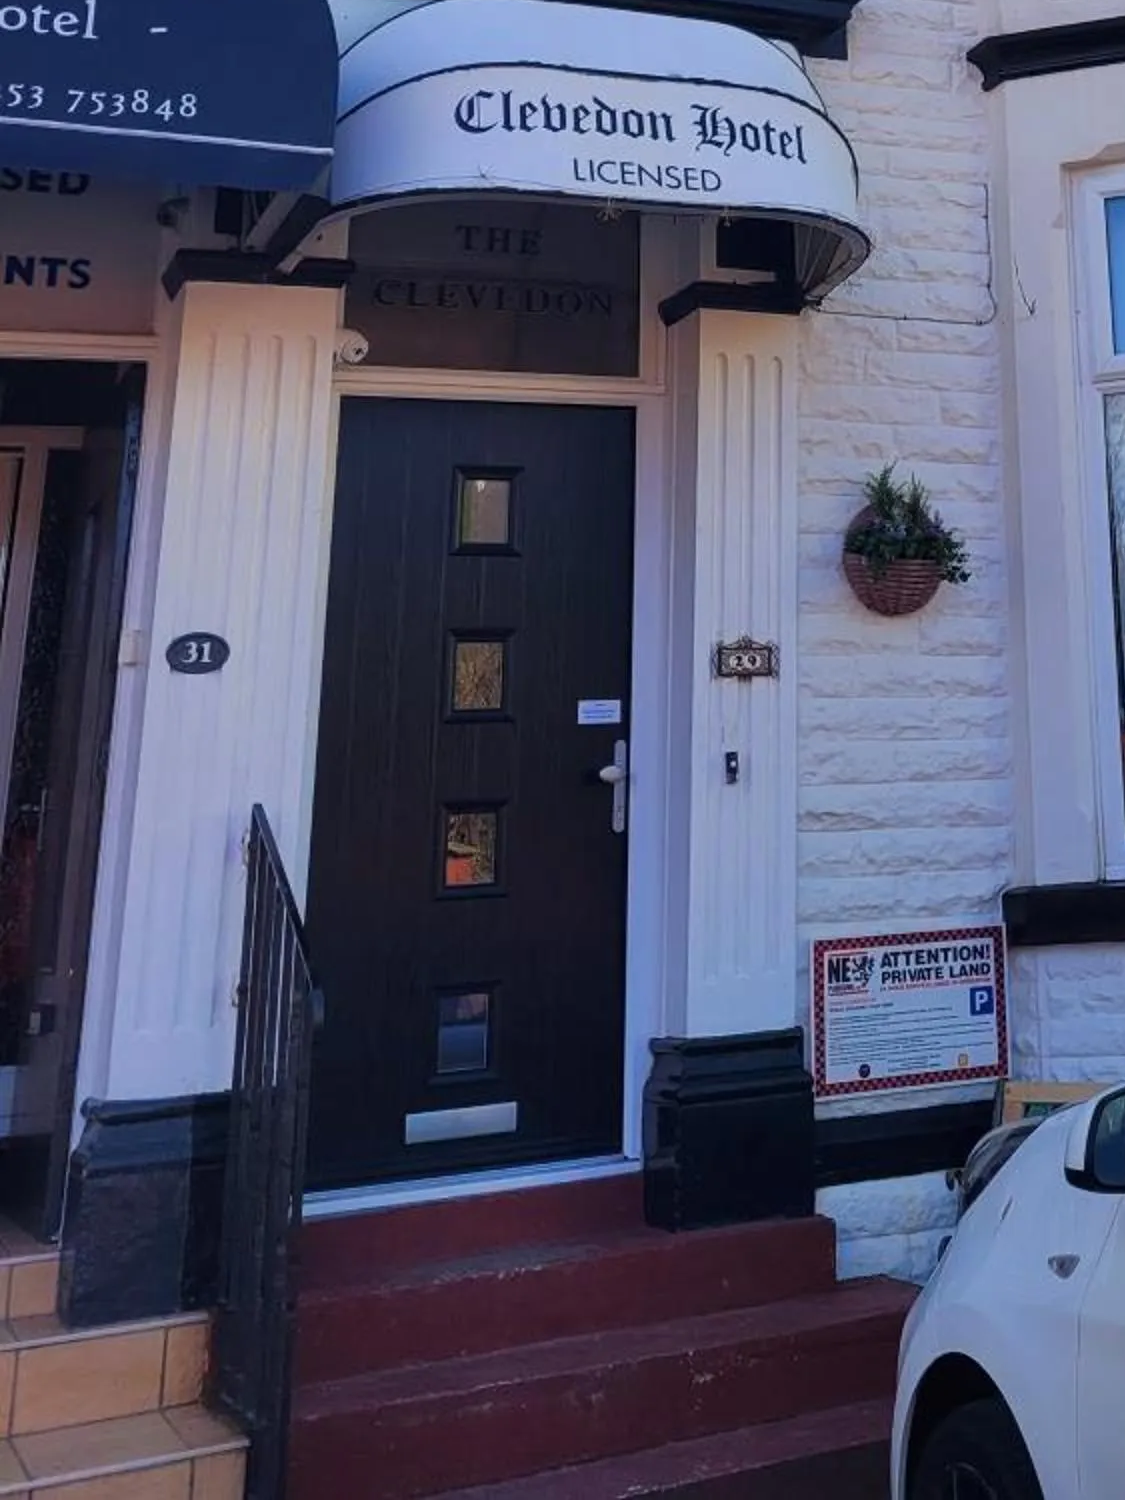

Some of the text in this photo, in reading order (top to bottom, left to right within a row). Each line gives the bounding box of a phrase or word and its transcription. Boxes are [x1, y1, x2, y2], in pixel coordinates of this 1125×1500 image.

[67, 89, 197, 121] 753848
[454, 90, 807, 164] Clevedon Hotel
[573, 157, 722, 192] LICENSED
[455, 225, 544, 255] THE
[181, 641, 213, 663] 31
[880, 944, 991, 969] ATTENTION!
[881, 962, 991, 985] PRIVATE LAND
